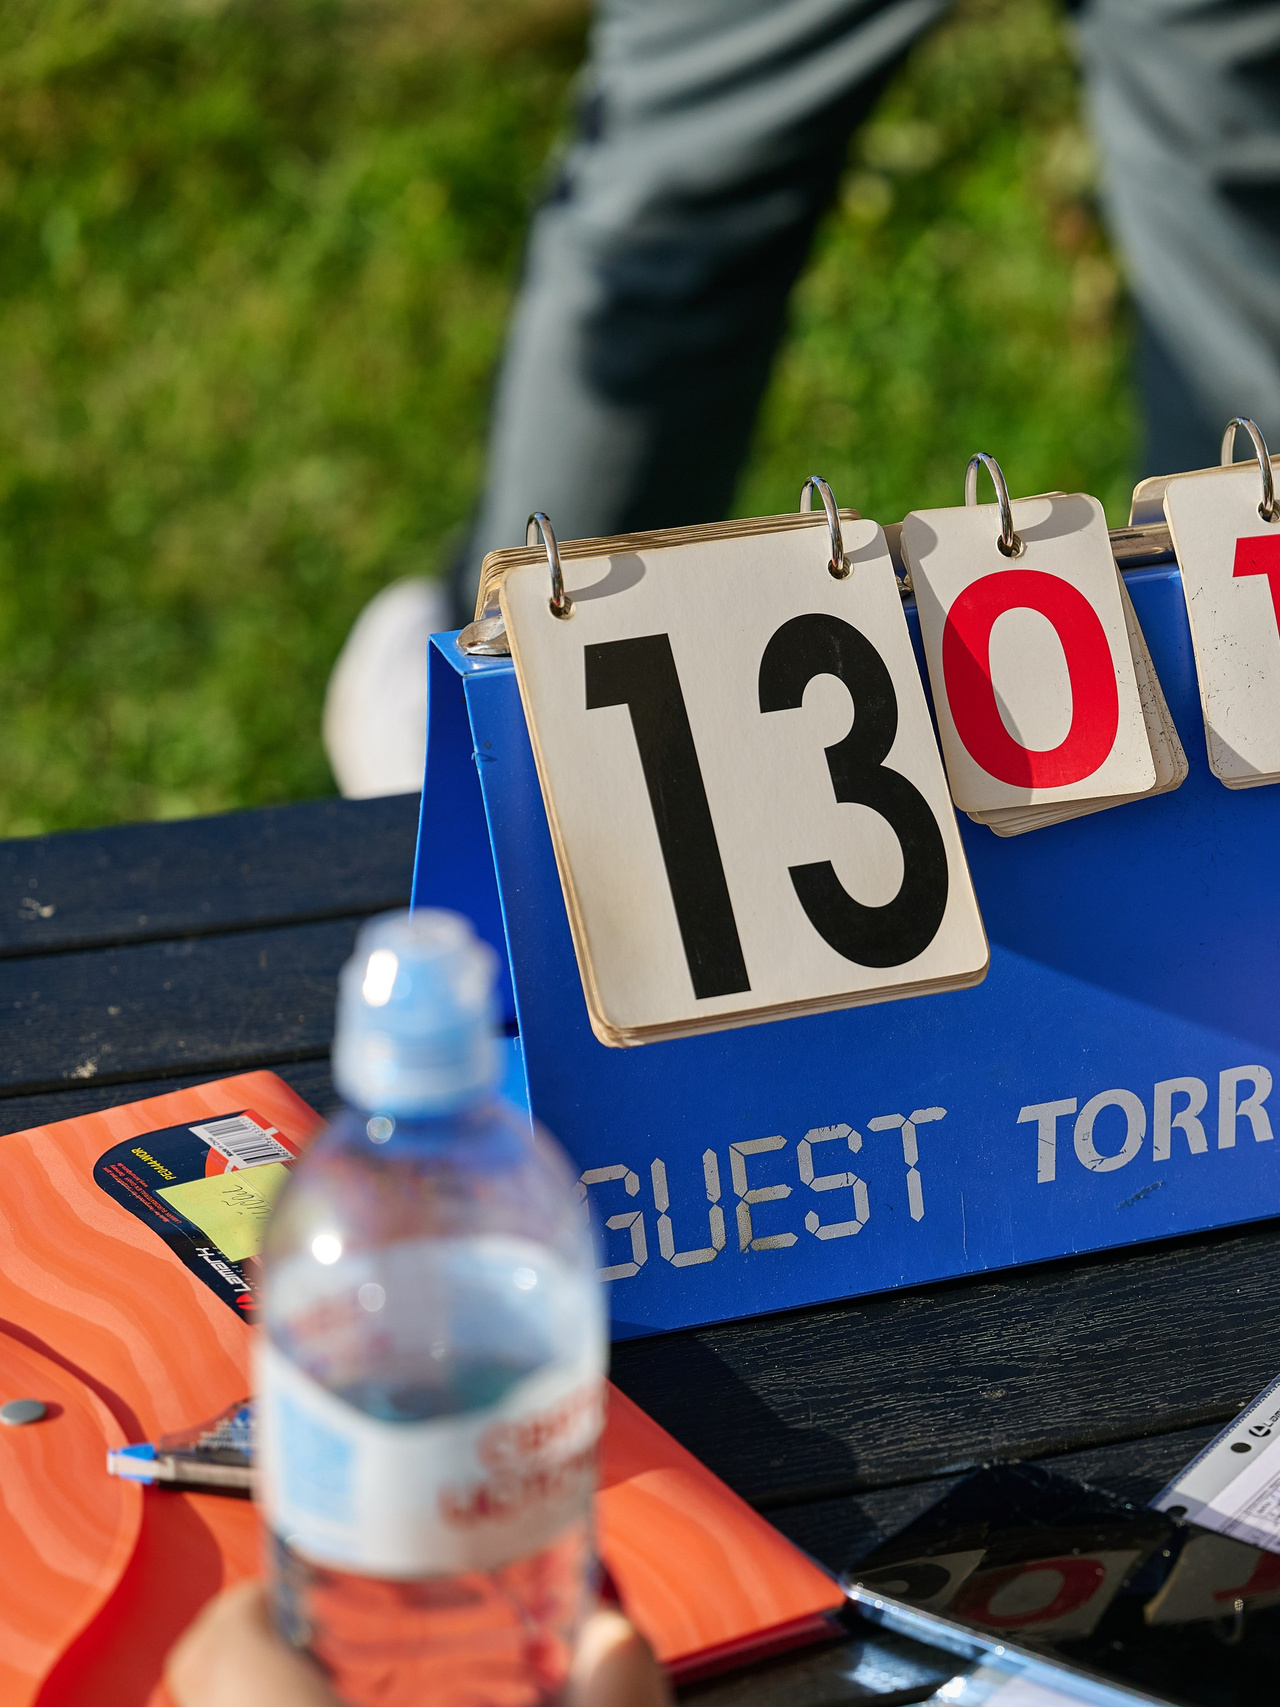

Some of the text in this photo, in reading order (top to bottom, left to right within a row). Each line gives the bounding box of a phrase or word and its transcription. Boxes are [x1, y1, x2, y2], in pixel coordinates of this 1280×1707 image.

[943, 569, 1119, 789] 0
[584, 614, 949, 1000] 13
[131, 1147, 177, 1181] PE0444-WOR
[576, 1106, 948, 1282] GUEST
[195, 1247, 252, 1292] Lamark
